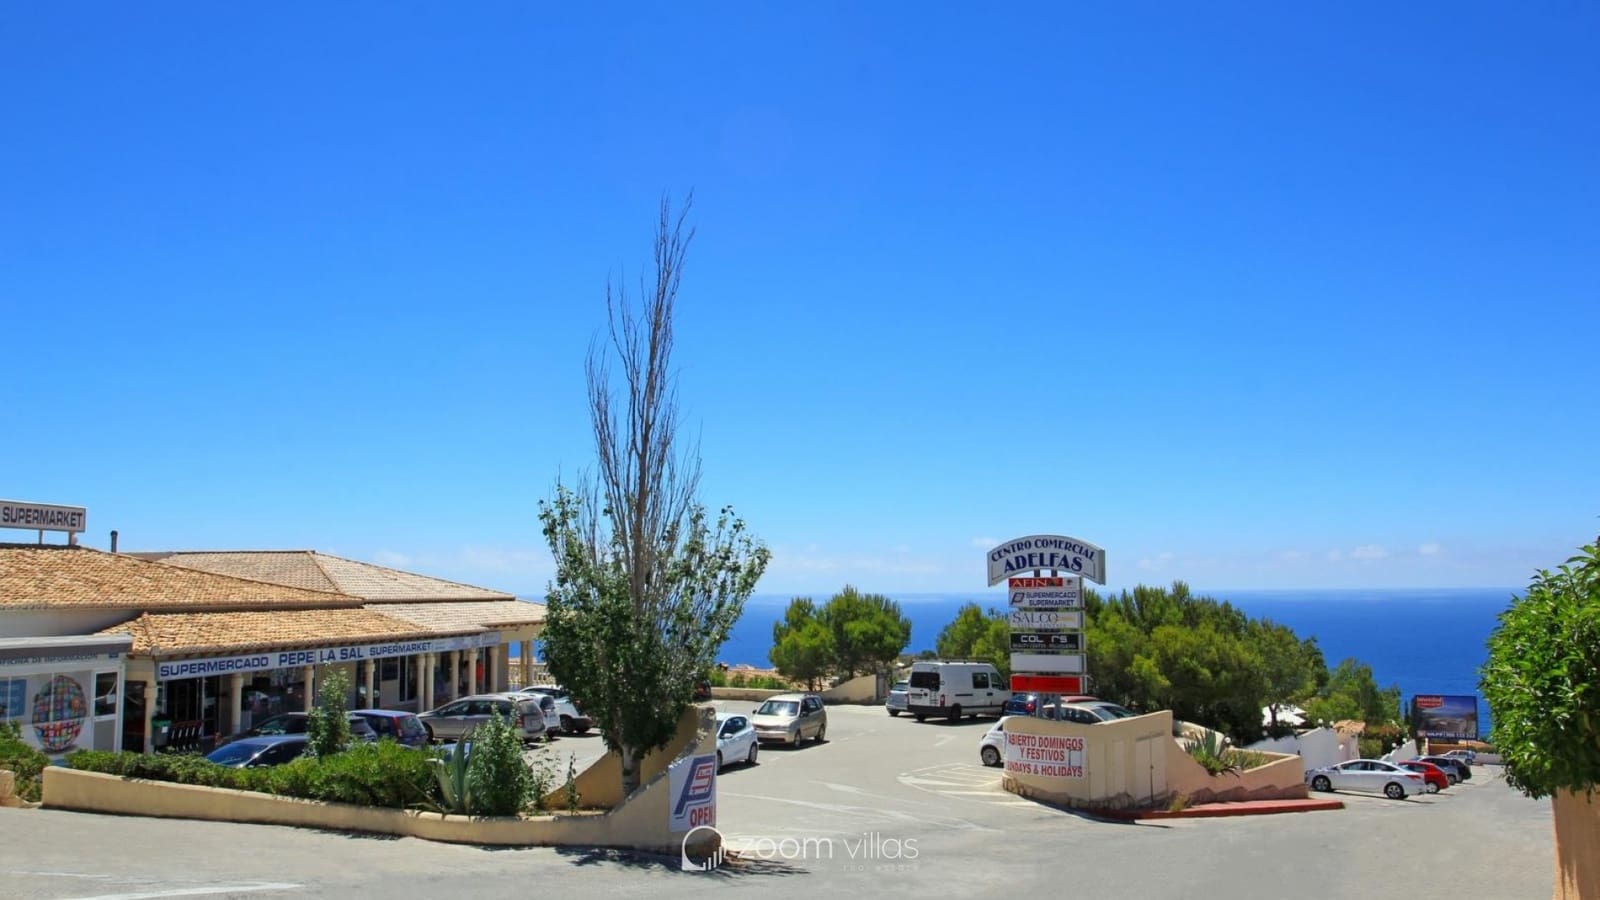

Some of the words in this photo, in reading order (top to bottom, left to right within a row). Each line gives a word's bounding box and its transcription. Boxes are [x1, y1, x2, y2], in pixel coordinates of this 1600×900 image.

[2, 506, 83, 528] SUPERMARKET
[991, 541, 1031, 562] CENTRO
[1034, 538, 1095, 560] COMERCIAL
[1004, 552, 1083, 573] ADELFAS
[1012, 612, 1058, 624] SALCO
[160, 656, 269, 677] SUPERMERCADO
[279, 651, 314, 665] PEPE
[320, 648, 336, 661] LA
[340, 648, 363, 660] SAL
[369, 642, 432, 656] SUPERMARKET
[1008, 735, 1036, 747] ABIERTO
[1038, 737, 1083, 751] DOMINGOS
[1020, 747, 1025, 758] Y
[1026, 748, 1065, 761] FESTIVOS
[1033, 765, 1039, 774] &
[1041, 765, 1083, 777] HOLIDAYS
[690, 806, 713, 827] OPEN
